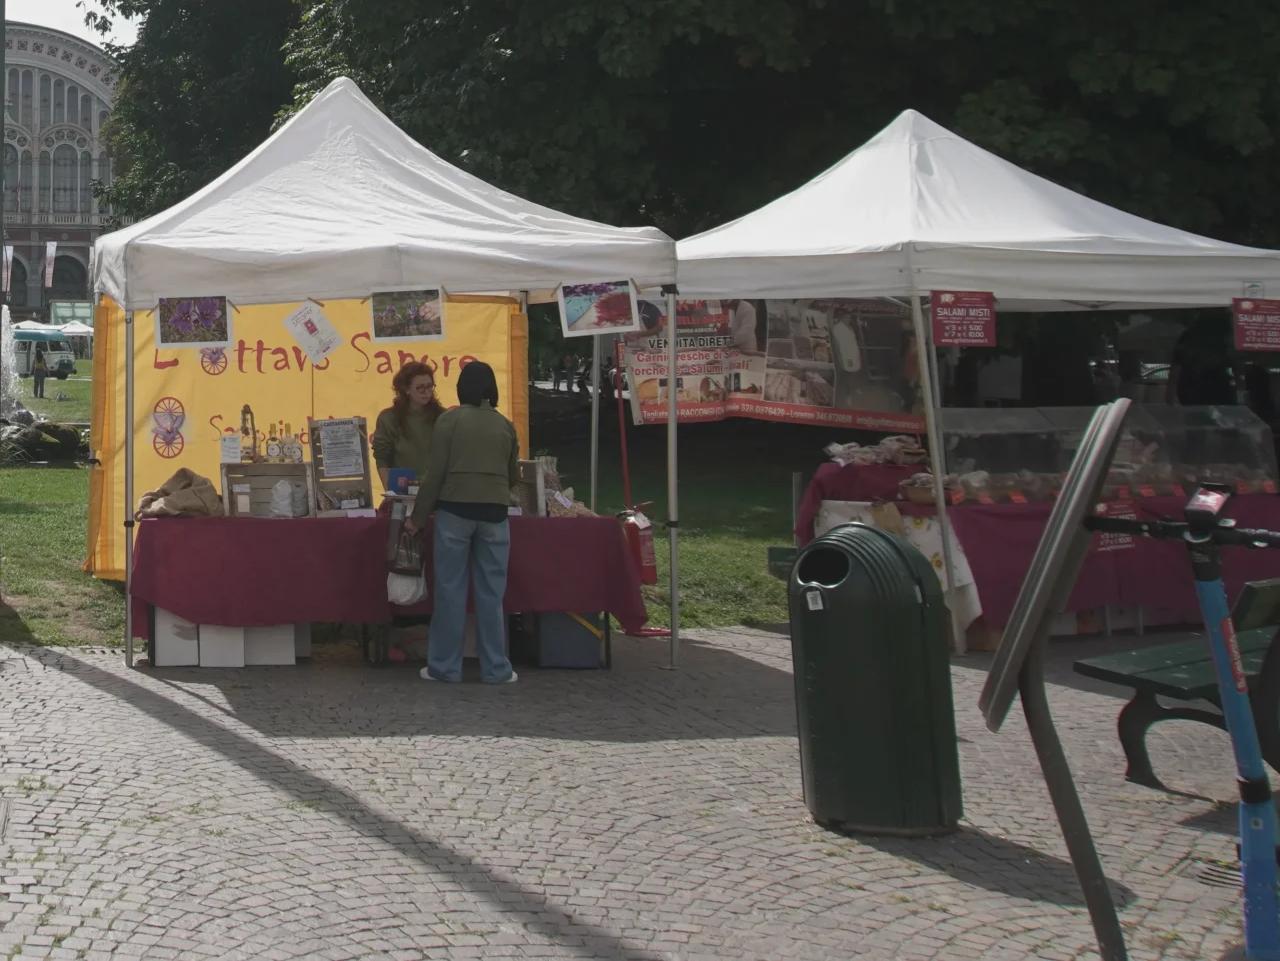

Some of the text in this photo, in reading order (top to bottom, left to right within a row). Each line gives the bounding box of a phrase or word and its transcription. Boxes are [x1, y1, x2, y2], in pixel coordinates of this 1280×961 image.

[937, 307, 991, 317] SALAMI MISTI
[1238, 314, 1280, 324] SALAMI MIS
[676, 351, 710, 361] resche
[690, 364, 723, 375] Salumi
